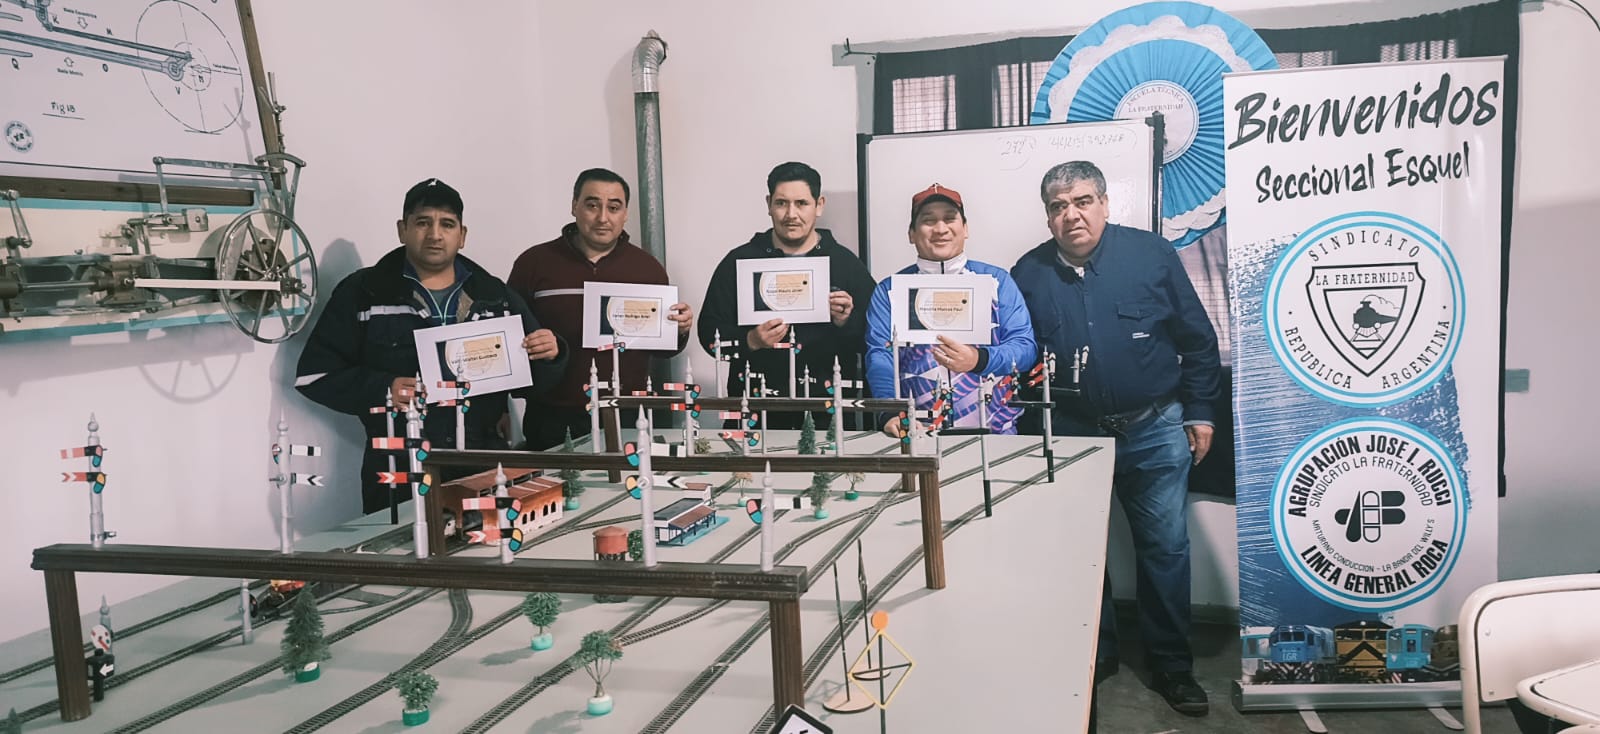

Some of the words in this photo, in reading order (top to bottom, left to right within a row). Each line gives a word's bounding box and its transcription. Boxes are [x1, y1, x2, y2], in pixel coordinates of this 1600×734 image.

[12, 58, 19, 70] Q
[1228, 72, 1499, 150] Bienvenidos
[1256, 153, 1376, 203] Seccional
[1384, 141, 1470, 187] Esquel
[1308, 230, 1420, 262] SINDICATO
[1316, 275, 1329, 286] LA
[1335, 272, 1415, 285] FRATERNIDAD
[1284, 326, 1352, 389] REPUBLICA
[1382, 320, 1450, 389] ARGENTINA
[1288, 435, 1361, 518] AGRUPACIÓN
[1366, 434, 1410, 459] JOSE
[1406, 447, 1420, 466] I.
[1417, 458, 1452, 507] RUCCI
[1309, 461, 1350, 508] SINDICATO
[1353, 456, 1368, 468] LA
[1372, 456, 1433, 507] FRATERNIDAD
[1300, 545, 1339, 586] LINEA
[1344, 573, 1416, 594] GENERAL
[1412, 539, 1448, 579] ROCA
[1312, 520, 1334, 554] MATURANO
[1392, 553, 1414, 569] BANDA
[1411, 544, 1424, 555] DEL
